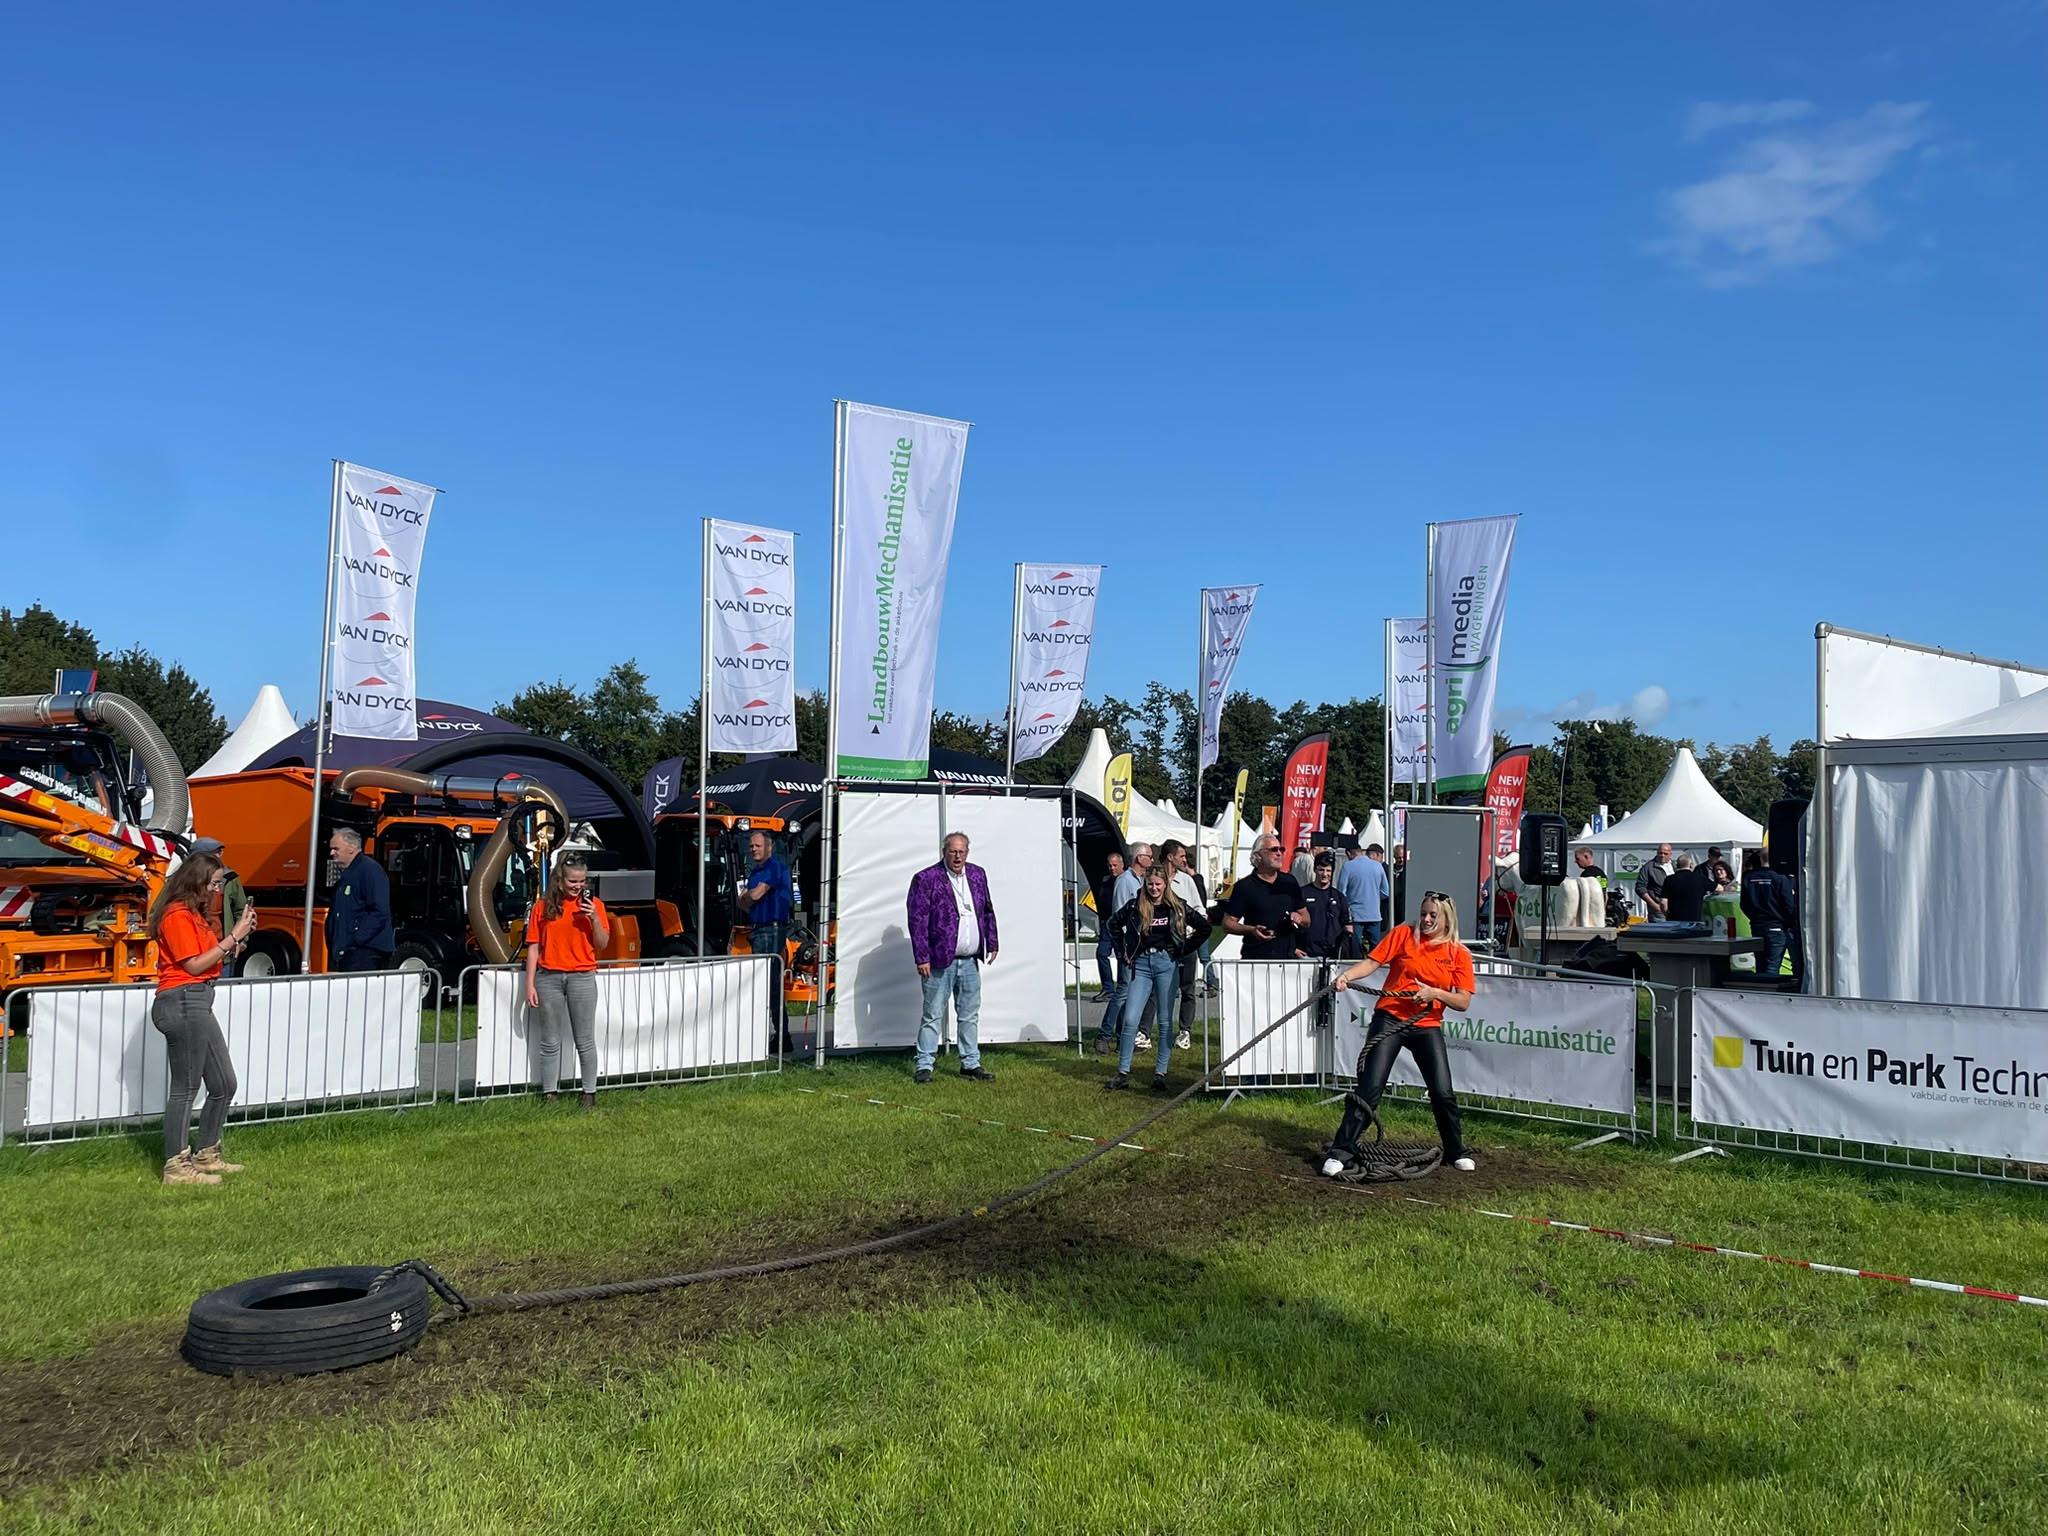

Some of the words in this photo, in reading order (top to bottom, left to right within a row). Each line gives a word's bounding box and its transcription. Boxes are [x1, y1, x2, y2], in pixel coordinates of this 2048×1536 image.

[345, 491, 377, 513] VAN
[380, 503, 424, 526] DYCK
[715, 543, 747, 559] VAN
[751, 549, 789, 566] DYCK
[343, 555, 377, 576] VAN
[380, 565, 413, 587] DYCK
[868, 437, 913, 723] LandbouwMechanisatie
[1025, 584, 1055, 595] VAN
[1058, 585, 1095, 597] DYCK
[714, 598, 749, 612] VAN
[753, 602, 792, 617] DYCK
[1210, 606, 1228, 616] VAN
[1229, 603, 1254, 615] DYCK
[1470, 565, 1488, 653] WAGENINGEN
[1451, 575, 1475, 659] media
[338, 622, 368, 641] VAN
[372, 630, 409, 649] DYCK
[1023, 631, 1052, 643] VAN
[1054, 633, 1091, 645] DYCK
[1395, 635, 1421, 643] VAN
[714, 656, 748, 669] VAN
[1395, 674, 1421, 684] VAN
[1020, 681, 1047, 692] VAN
[1049, 681, 1084, 692] DYCK
[365, 694, 413, 711] DYCK
[1445, 677, 1467, 735] agri
[713, 713, 748, 726] VAN
[752, 714, 791, 727] DYCK
[1395, 714, 1420, 724] VAN
[437, 722, 484, 731] DYCK
[1394, 755, 1420, 764] VAN
[1296, 764, 1323, 775] NEW
[19, 765, 54, 788] GESCHIKT
[55, 781, 72, 797] VOOR
[1289, 776, 1311, 785] NEW
[1498, 775, 1523, 786] NEW
[1287, 786, 1320, 798] NEW
[1491, 786, 1512, 795] NEW
[1293, 799, 1311, 808] NEW
[1488, 795, 1520, 807] NEW
[1291, 809, 1316, 819] NEW
[1298, 822, 1313, 849] NE
[1498, 829, 1514, 853] NE
[1360, 1007, 1616, 1055] LwMechanisatie
[1750, 1038, 1814, 1076] Tuin
[1822, 1054, 1858, 1081] en
[1867, 1048, 1947, 1089] Park
[1911, 1091, 1947, 1102] vakblad
[1949, 1096, 1971, 1104] over
[1974, 1096, 2014, 1108] techniek
[2017, 1100, 2026, 1109] in
[2028, 1101, 2041, 1111] de
